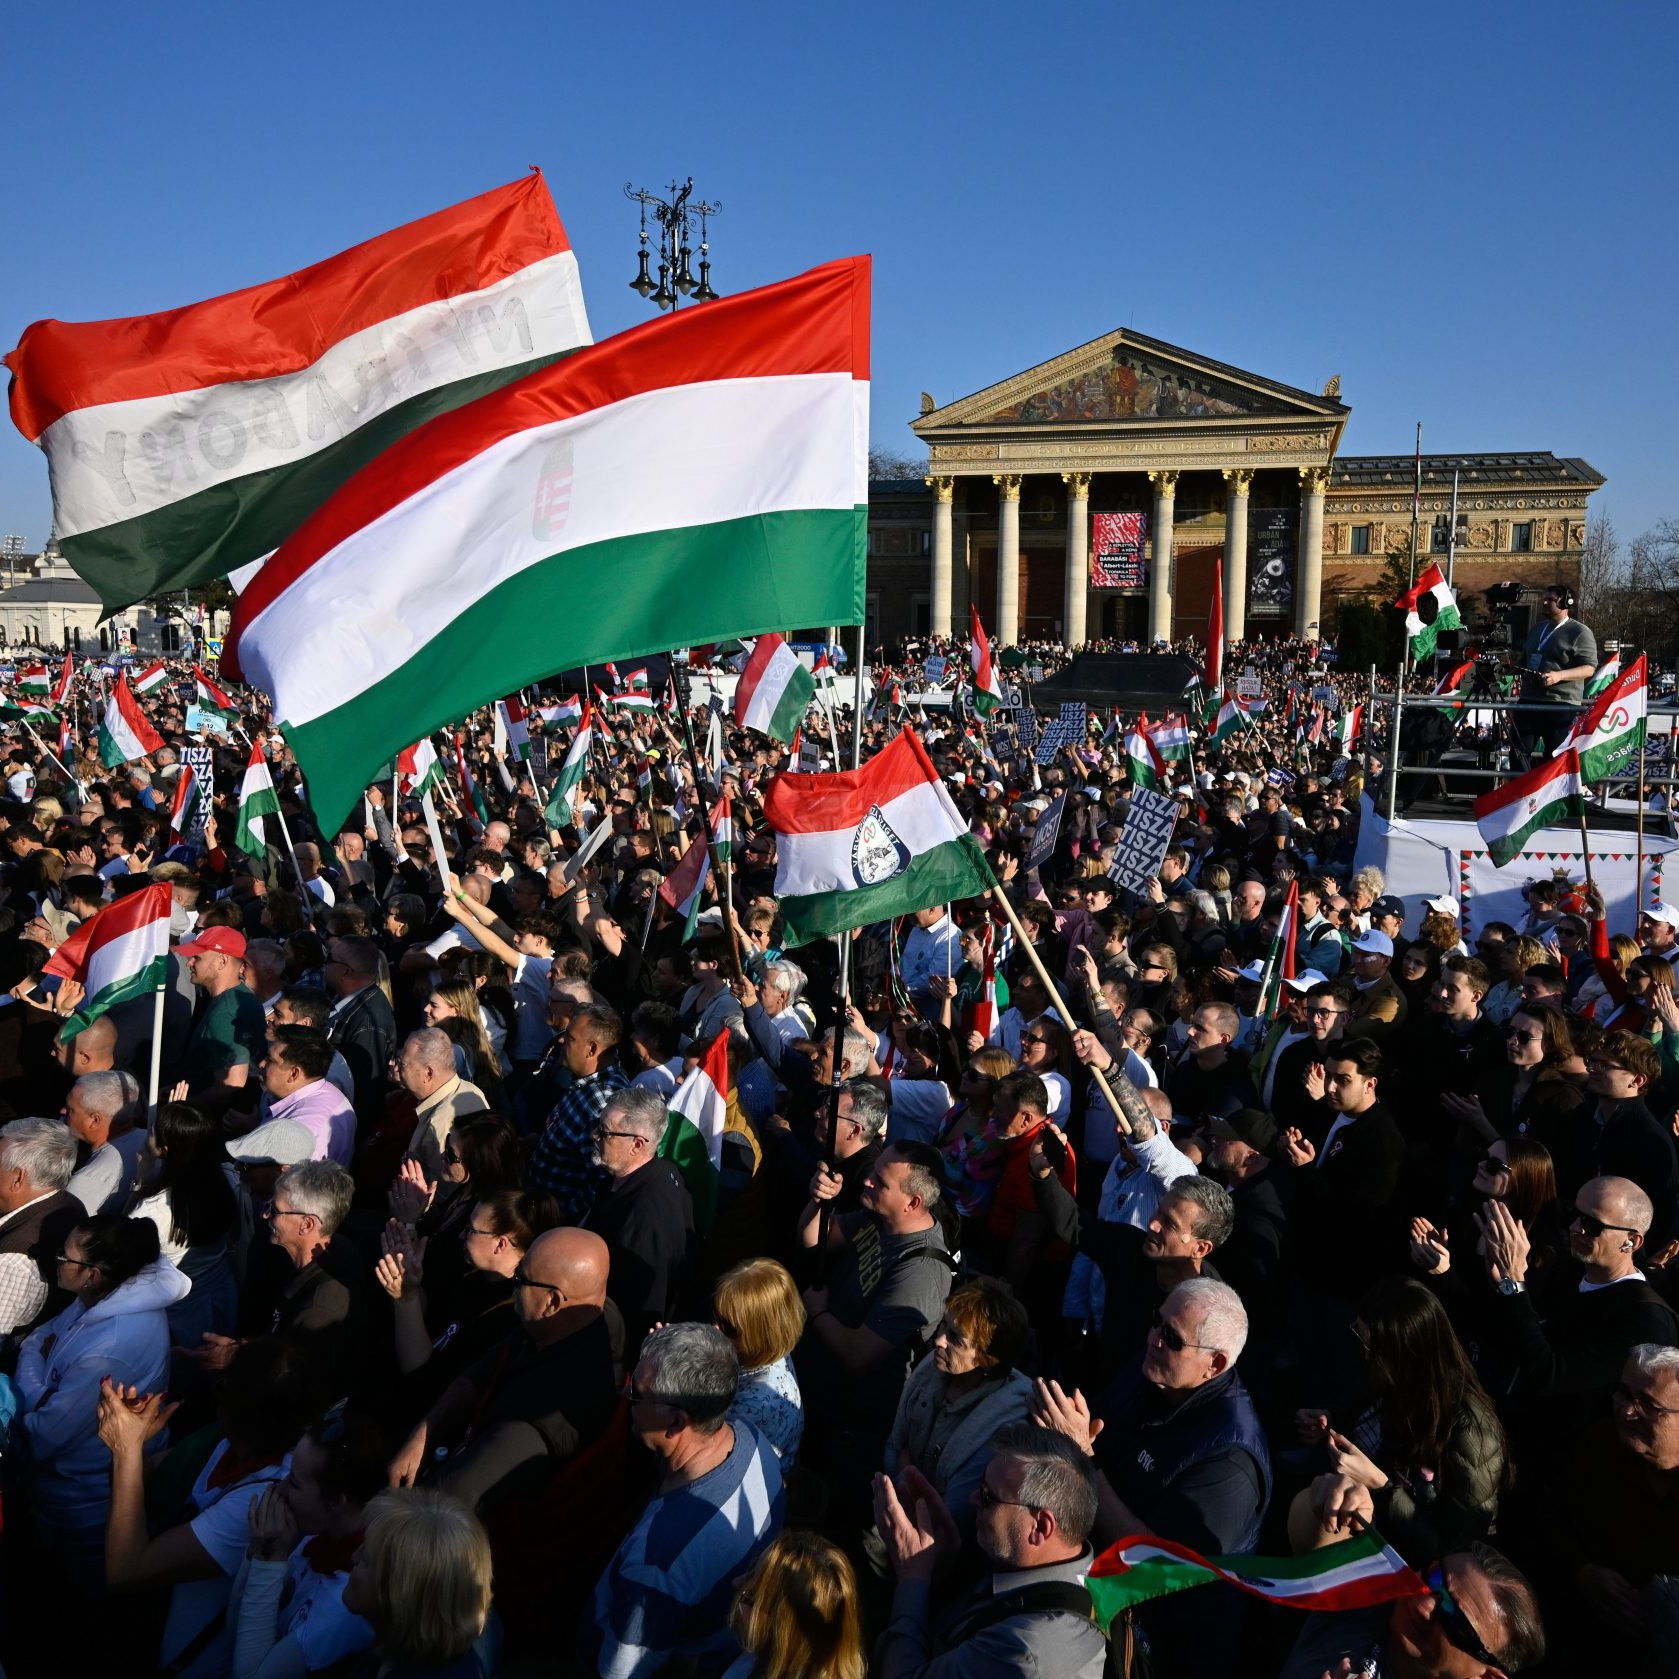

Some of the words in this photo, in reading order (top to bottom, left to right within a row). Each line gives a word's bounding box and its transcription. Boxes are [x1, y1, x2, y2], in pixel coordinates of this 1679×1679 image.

[1015, 709, 1036, 717] TISZA
[1061, 703, 1086, 711] TISZA
[1016, 717, 1036, 725] TISZA
[1060, 711, 1086, 720] TISZA
[1018, 732, 1038, 740] TISZA
[181, 748, 212, 763] TISZA
[1036, 747, 1058, 755] TISZA
[180, 765, 213, 779] TSZA
[1132, 785, 1180, 819] TISZA
[1126, 804, 1173, 838] TISZA
[1120, 823, 1168, 859] TISZA
[1114, 842, 1161, 878] TISZA
[1107, 862, 1150, 899] TISZA
